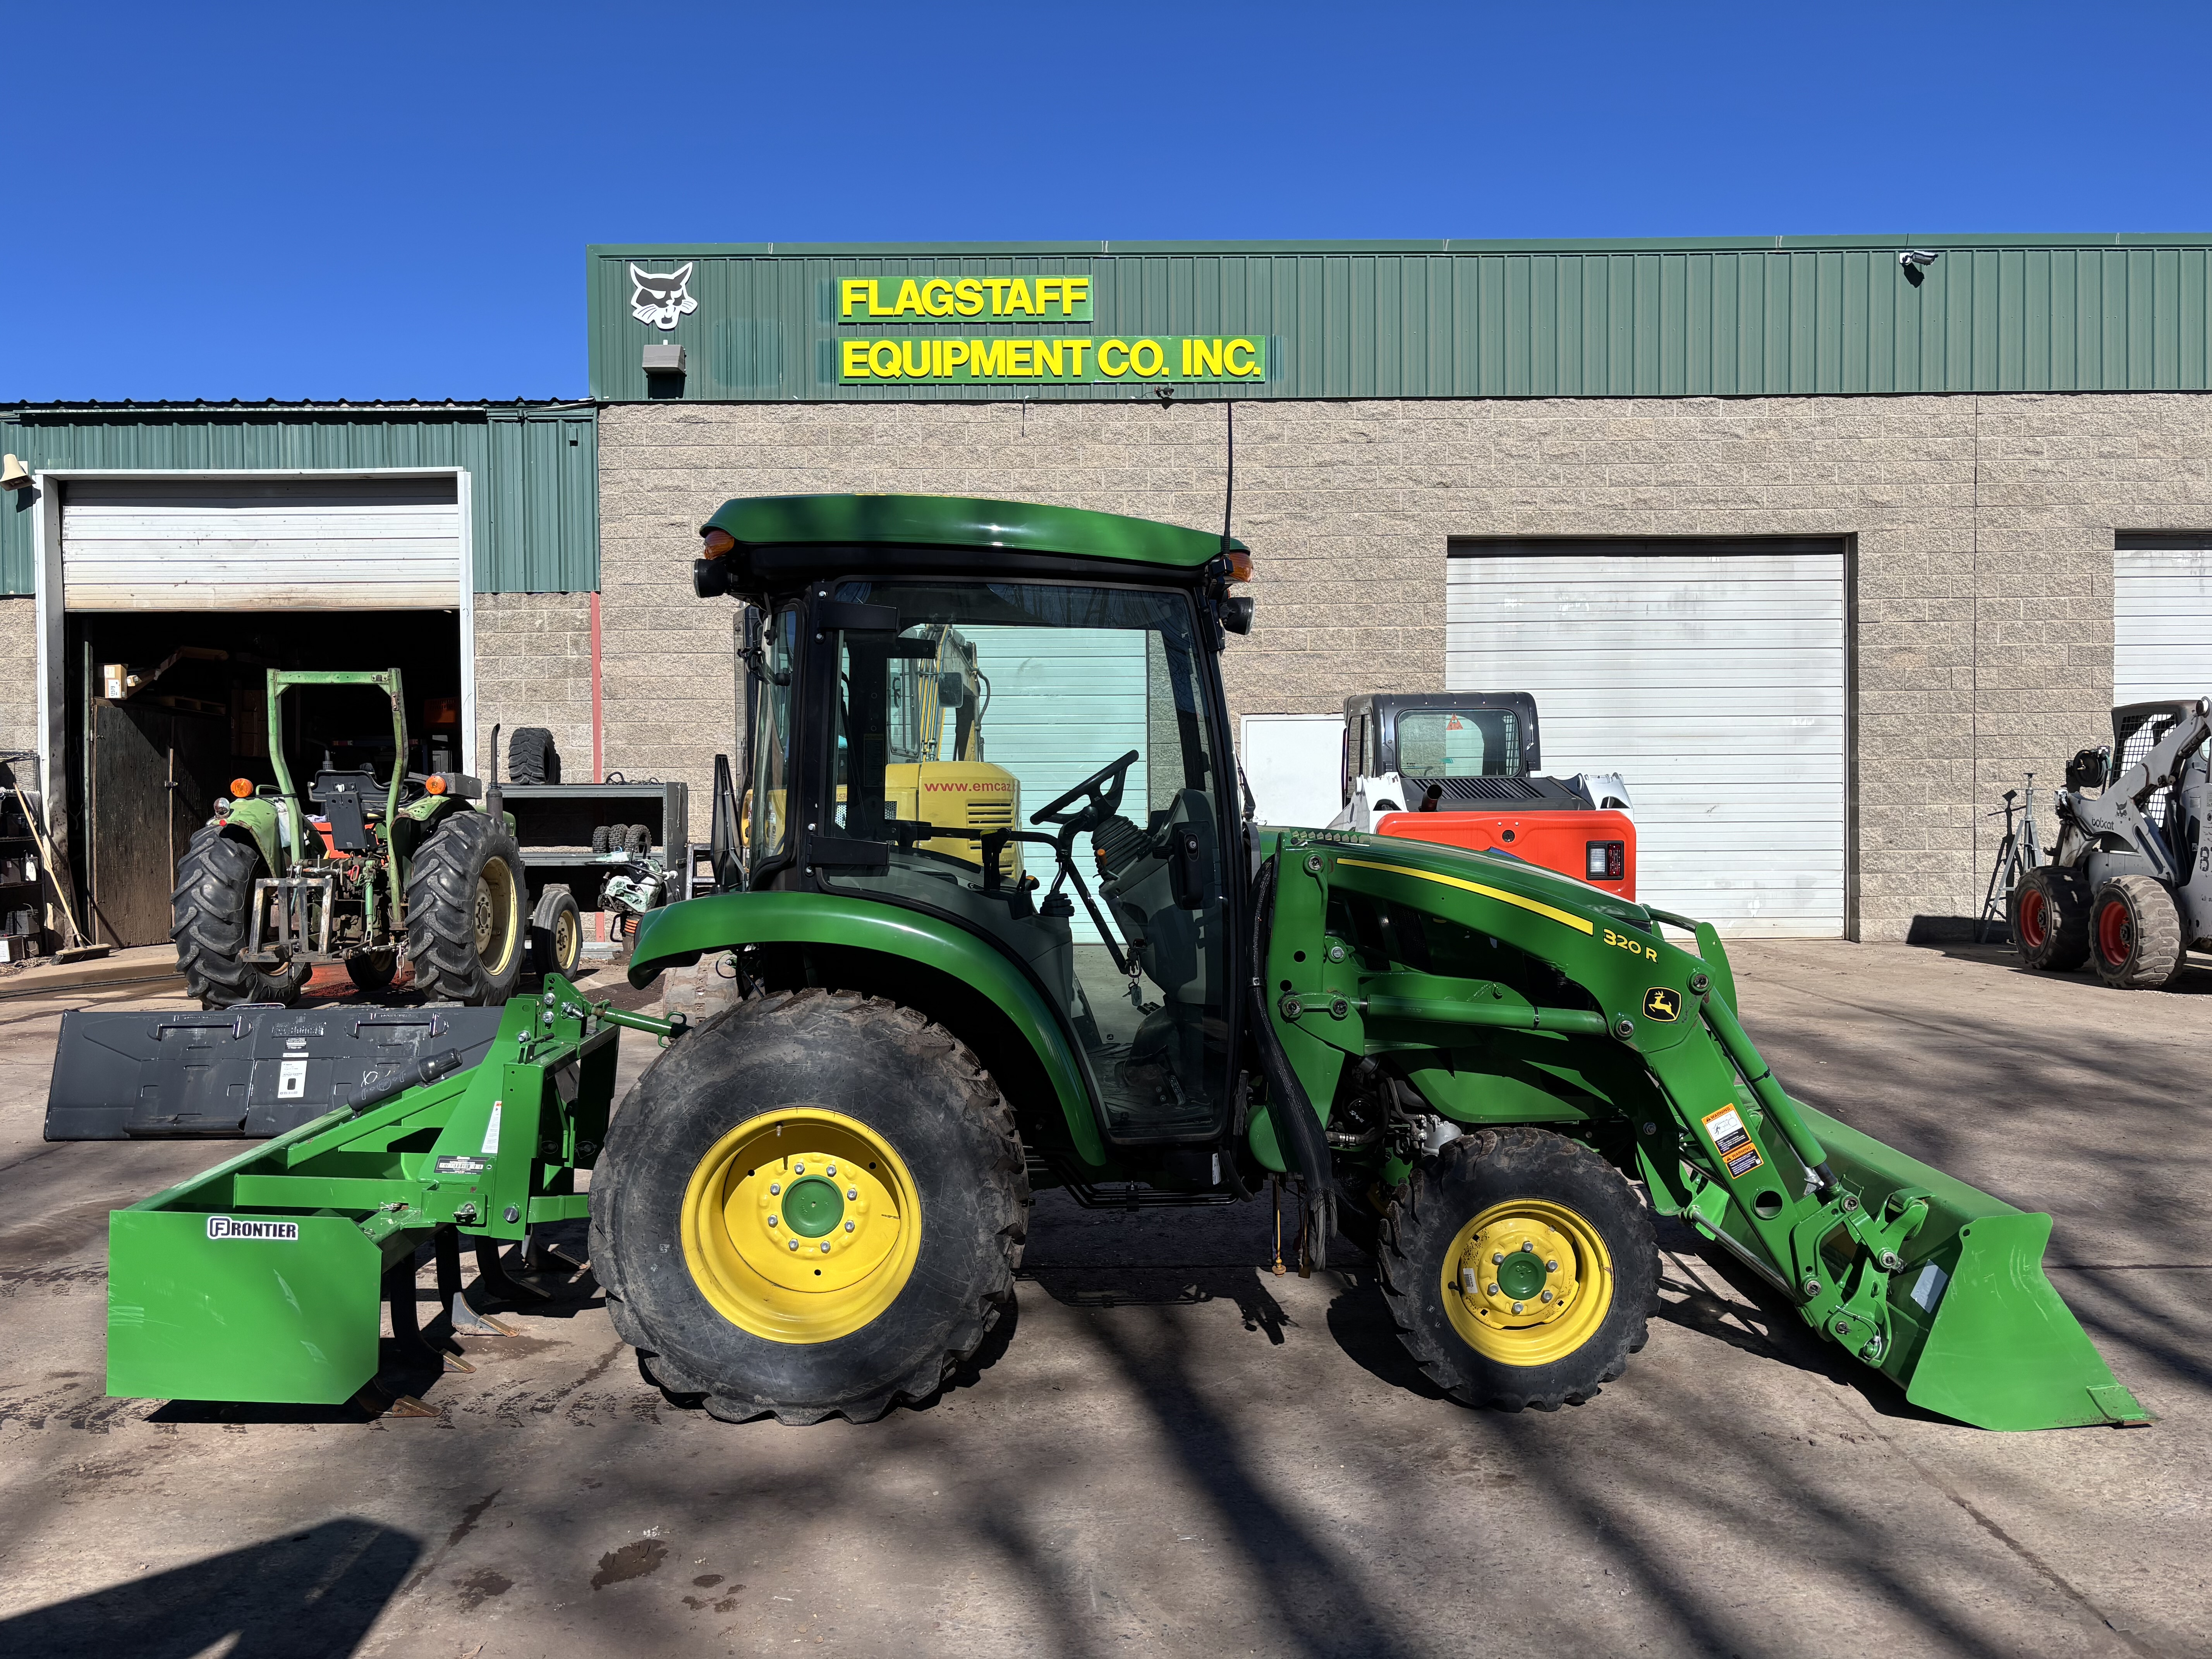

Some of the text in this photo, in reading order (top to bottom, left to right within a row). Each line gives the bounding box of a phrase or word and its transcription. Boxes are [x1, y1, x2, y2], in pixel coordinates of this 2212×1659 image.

[842, 278, 1089, 317] FLAGSTAFF
[843, 339, 1262, 379] EQUIPMENT CO. INC.
[1603, 928, 1657, 963] 320 R
[1710, 1107, 1731, 1120] WARNING
[1731, 1146, 1752, 1159] WARNING
[210, 1218, 296, 1238] FRONTIER
